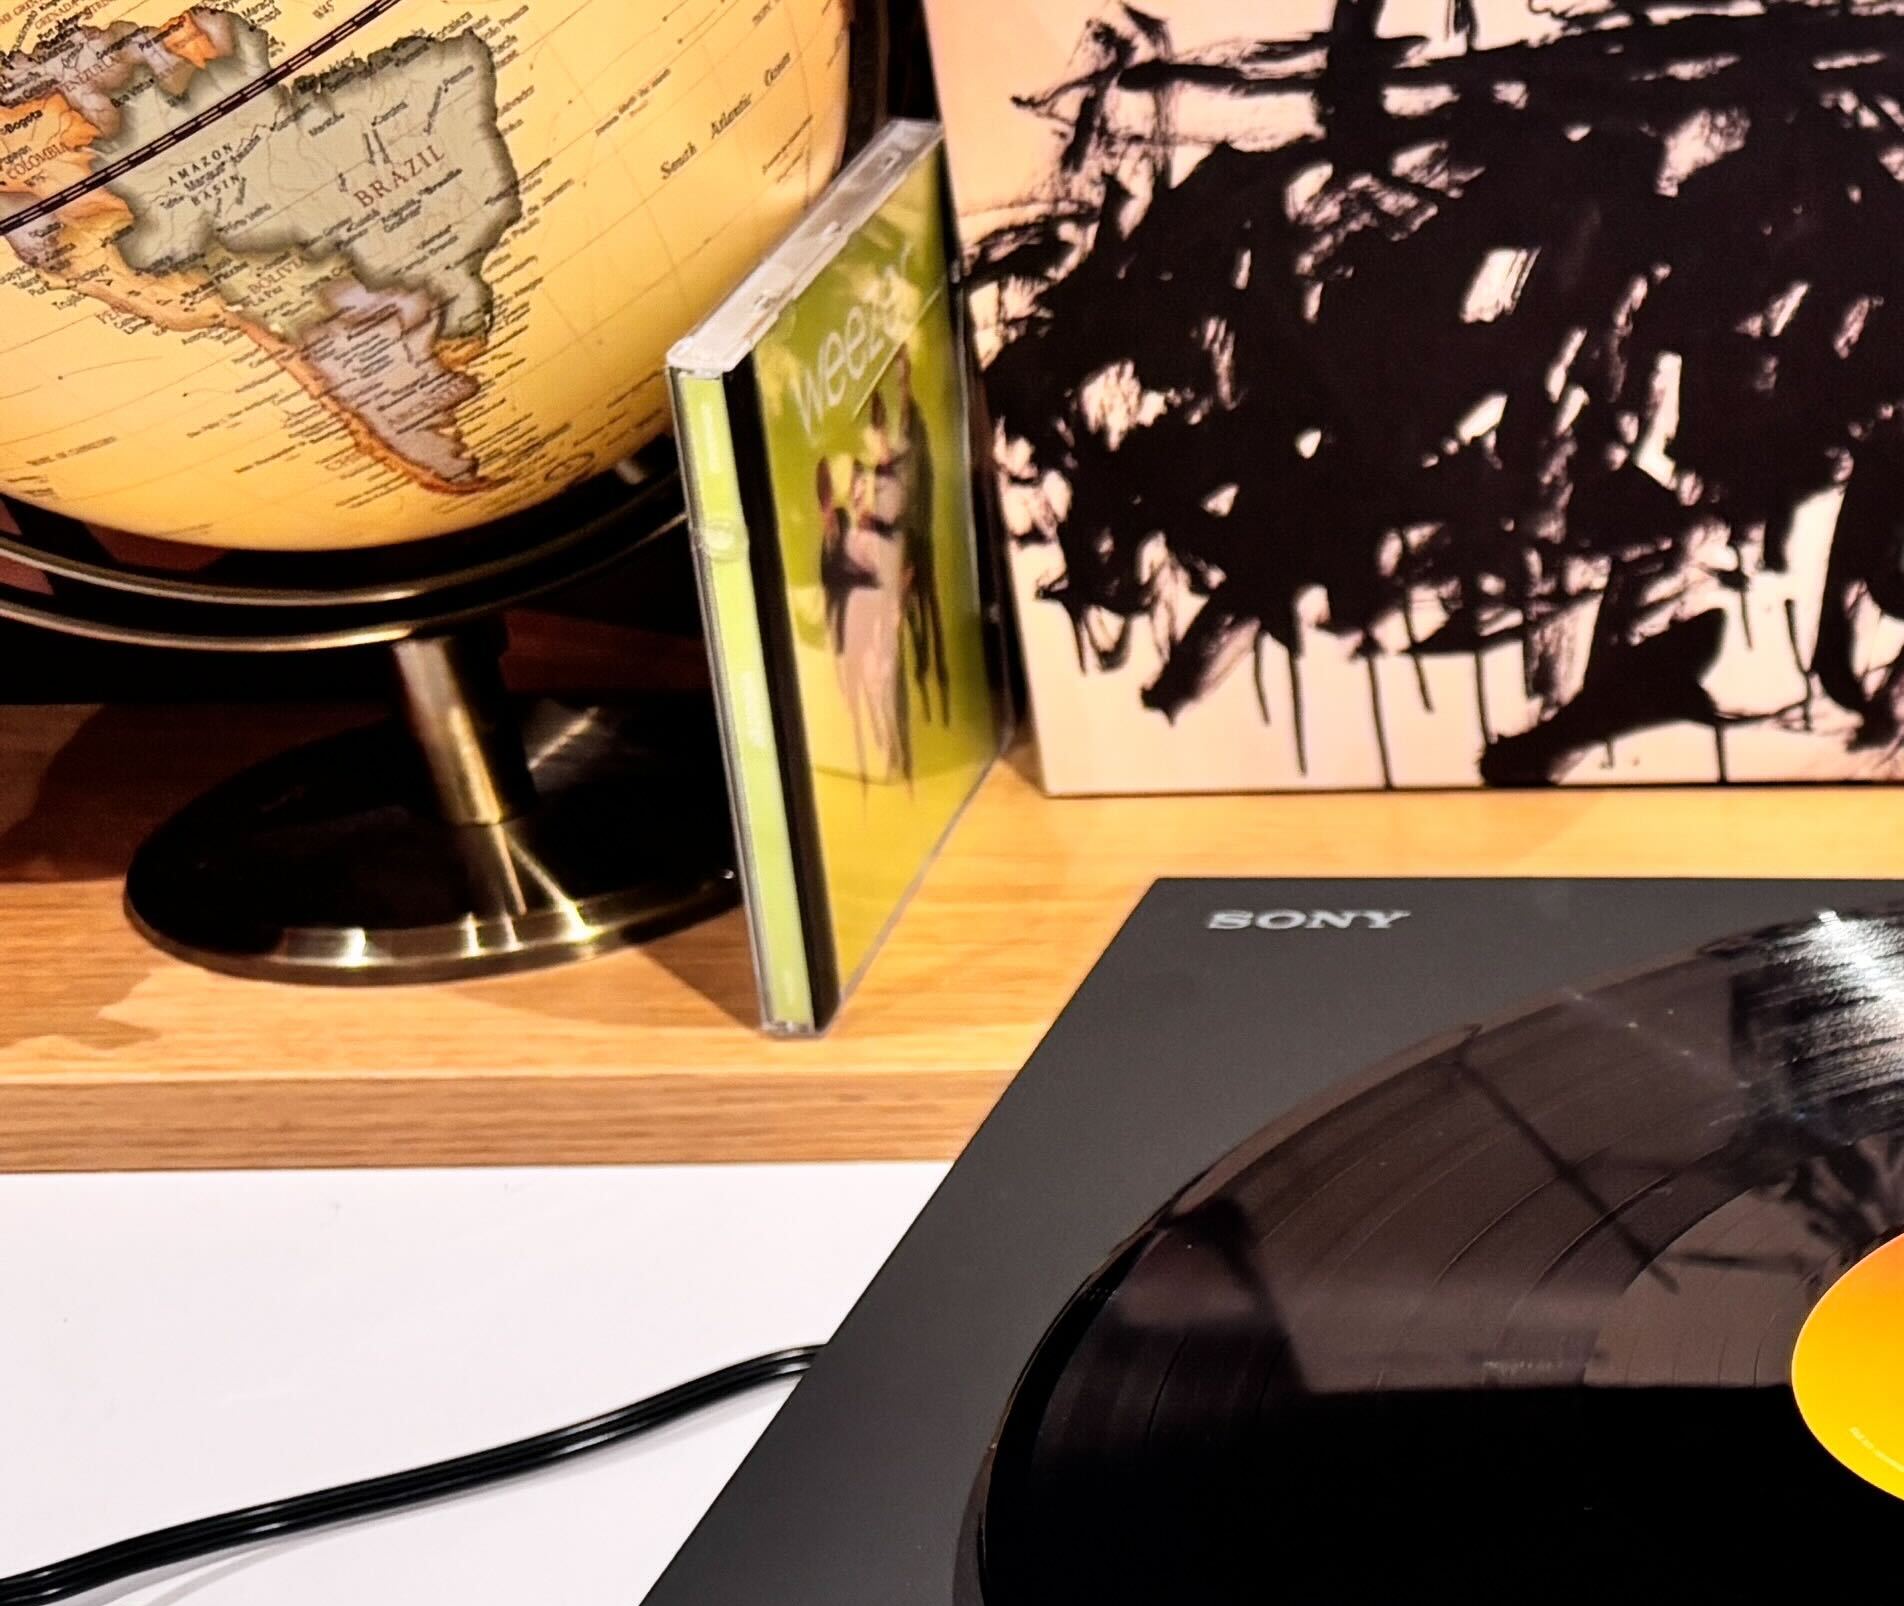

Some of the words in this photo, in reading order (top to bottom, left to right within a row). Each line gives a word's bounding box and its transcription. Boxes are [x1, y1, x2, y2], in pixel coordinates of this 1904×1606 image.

[168, 142, 234, 185] AMAZON
[353, 144, 446, 208] BRAZIL
[1207, 910, 1411, 930] SONY
